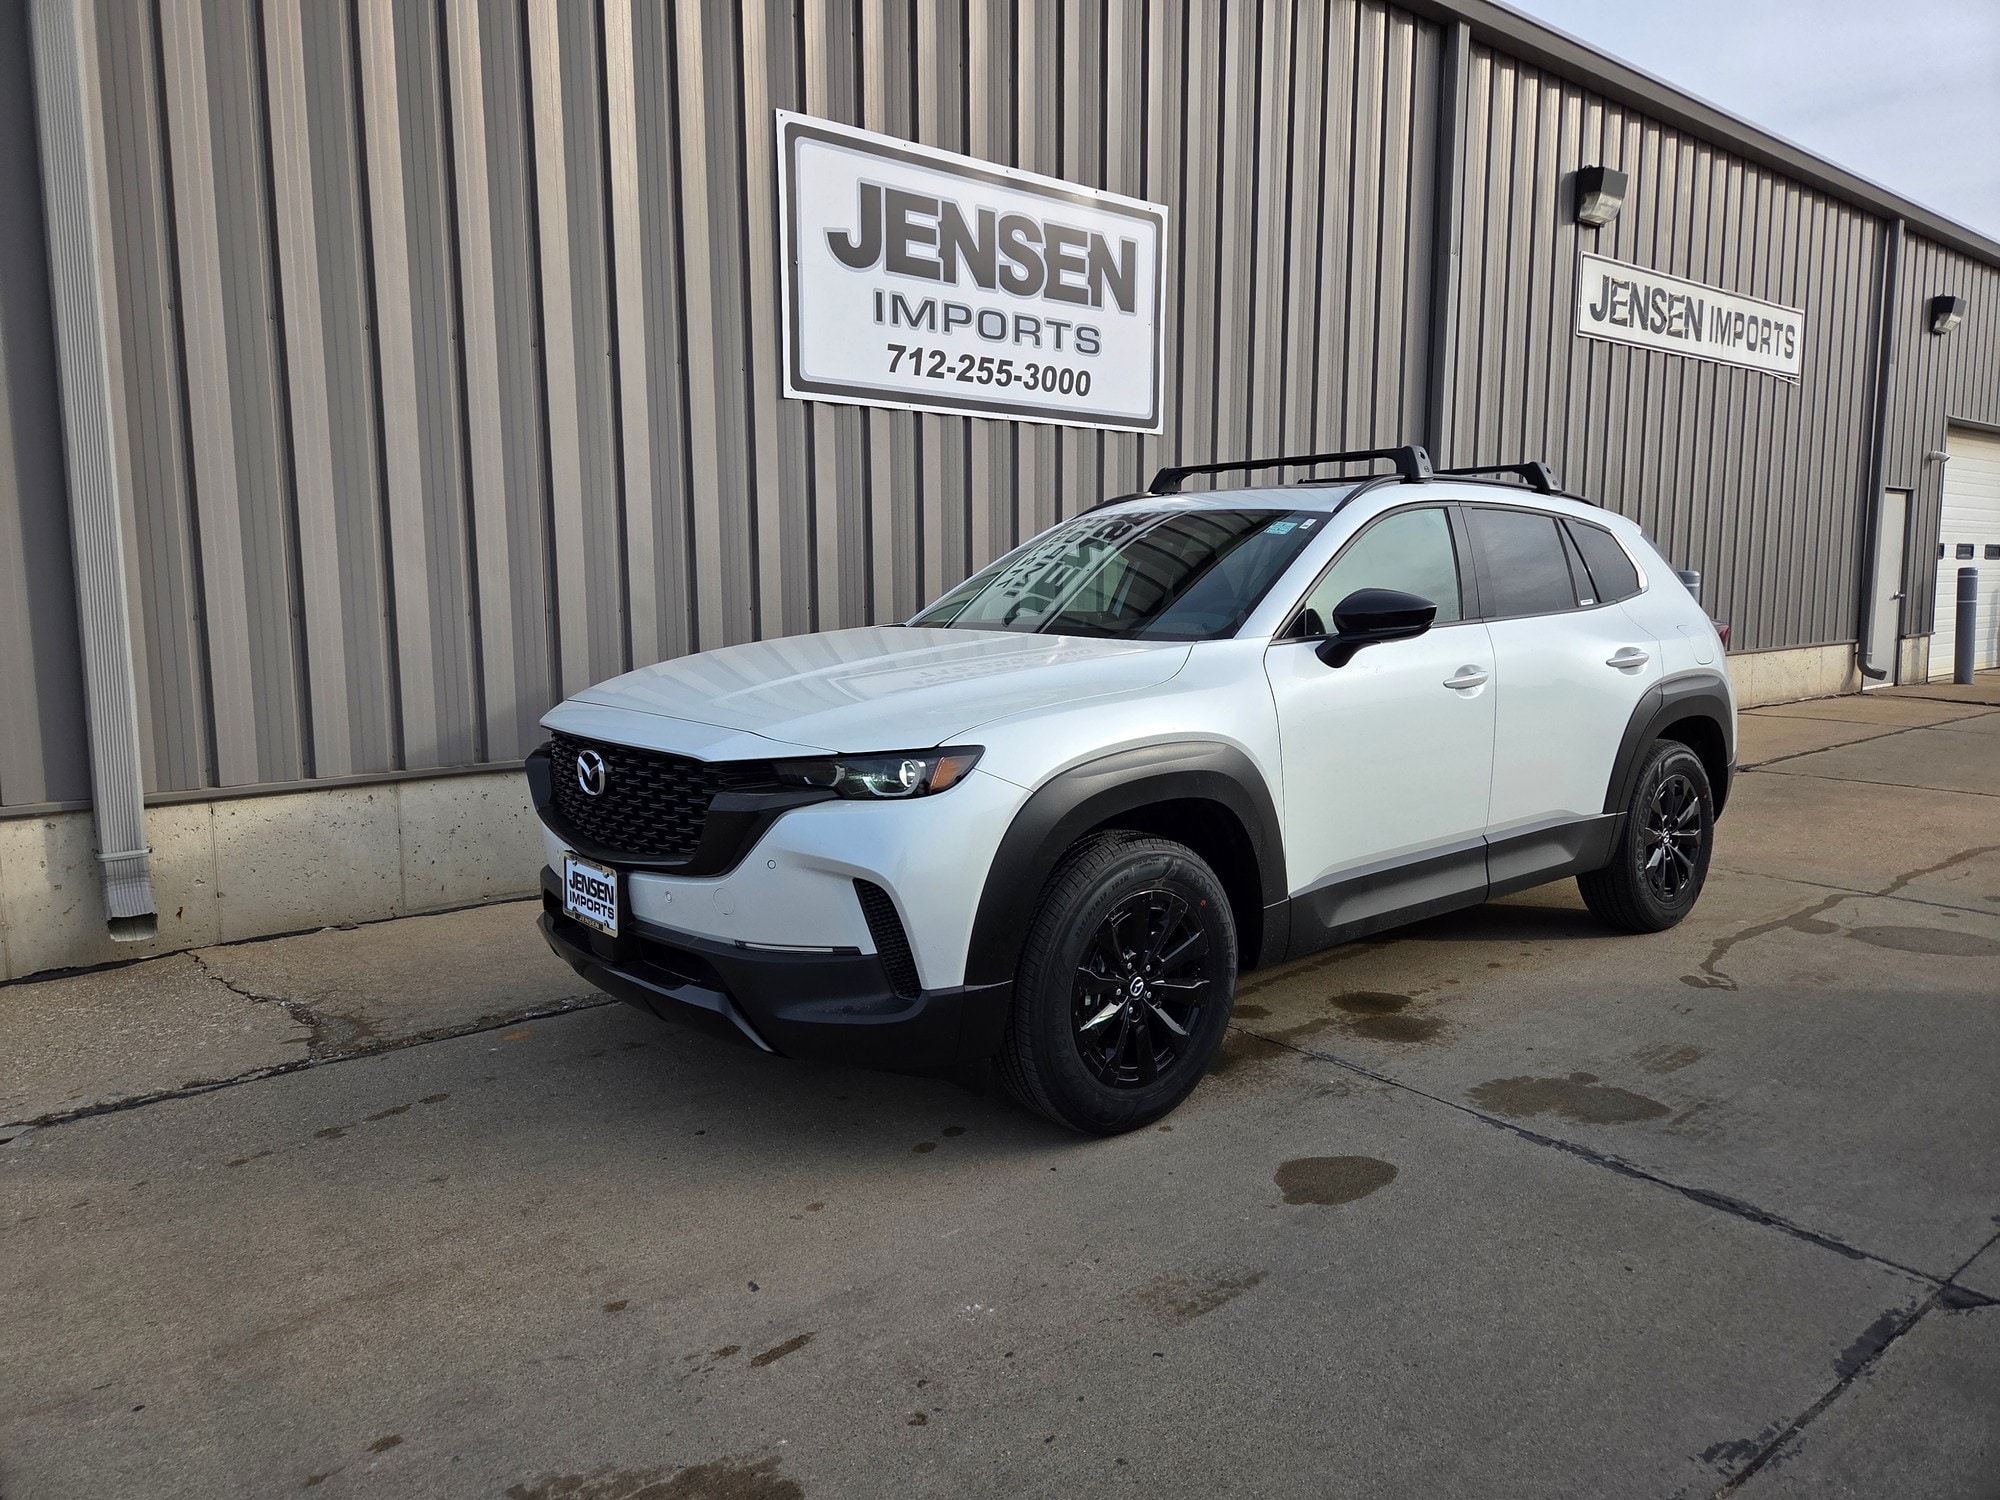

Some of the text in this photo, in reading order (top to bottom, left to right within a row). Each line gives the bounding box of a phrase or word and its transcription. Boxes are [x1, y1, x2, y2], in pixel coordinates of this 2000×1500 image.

[825, 180, 1138, 315] JENSEN
[873, 289, 1101, 356] IMPORTS
[1589, 274, 1796, 359] JENSEN IMPORTS
[886, 343, 1092, 397] 712-255-3000
[569, 871, 614, 905] JENSEN
[569, 890, 614, 920] IMPORTS
